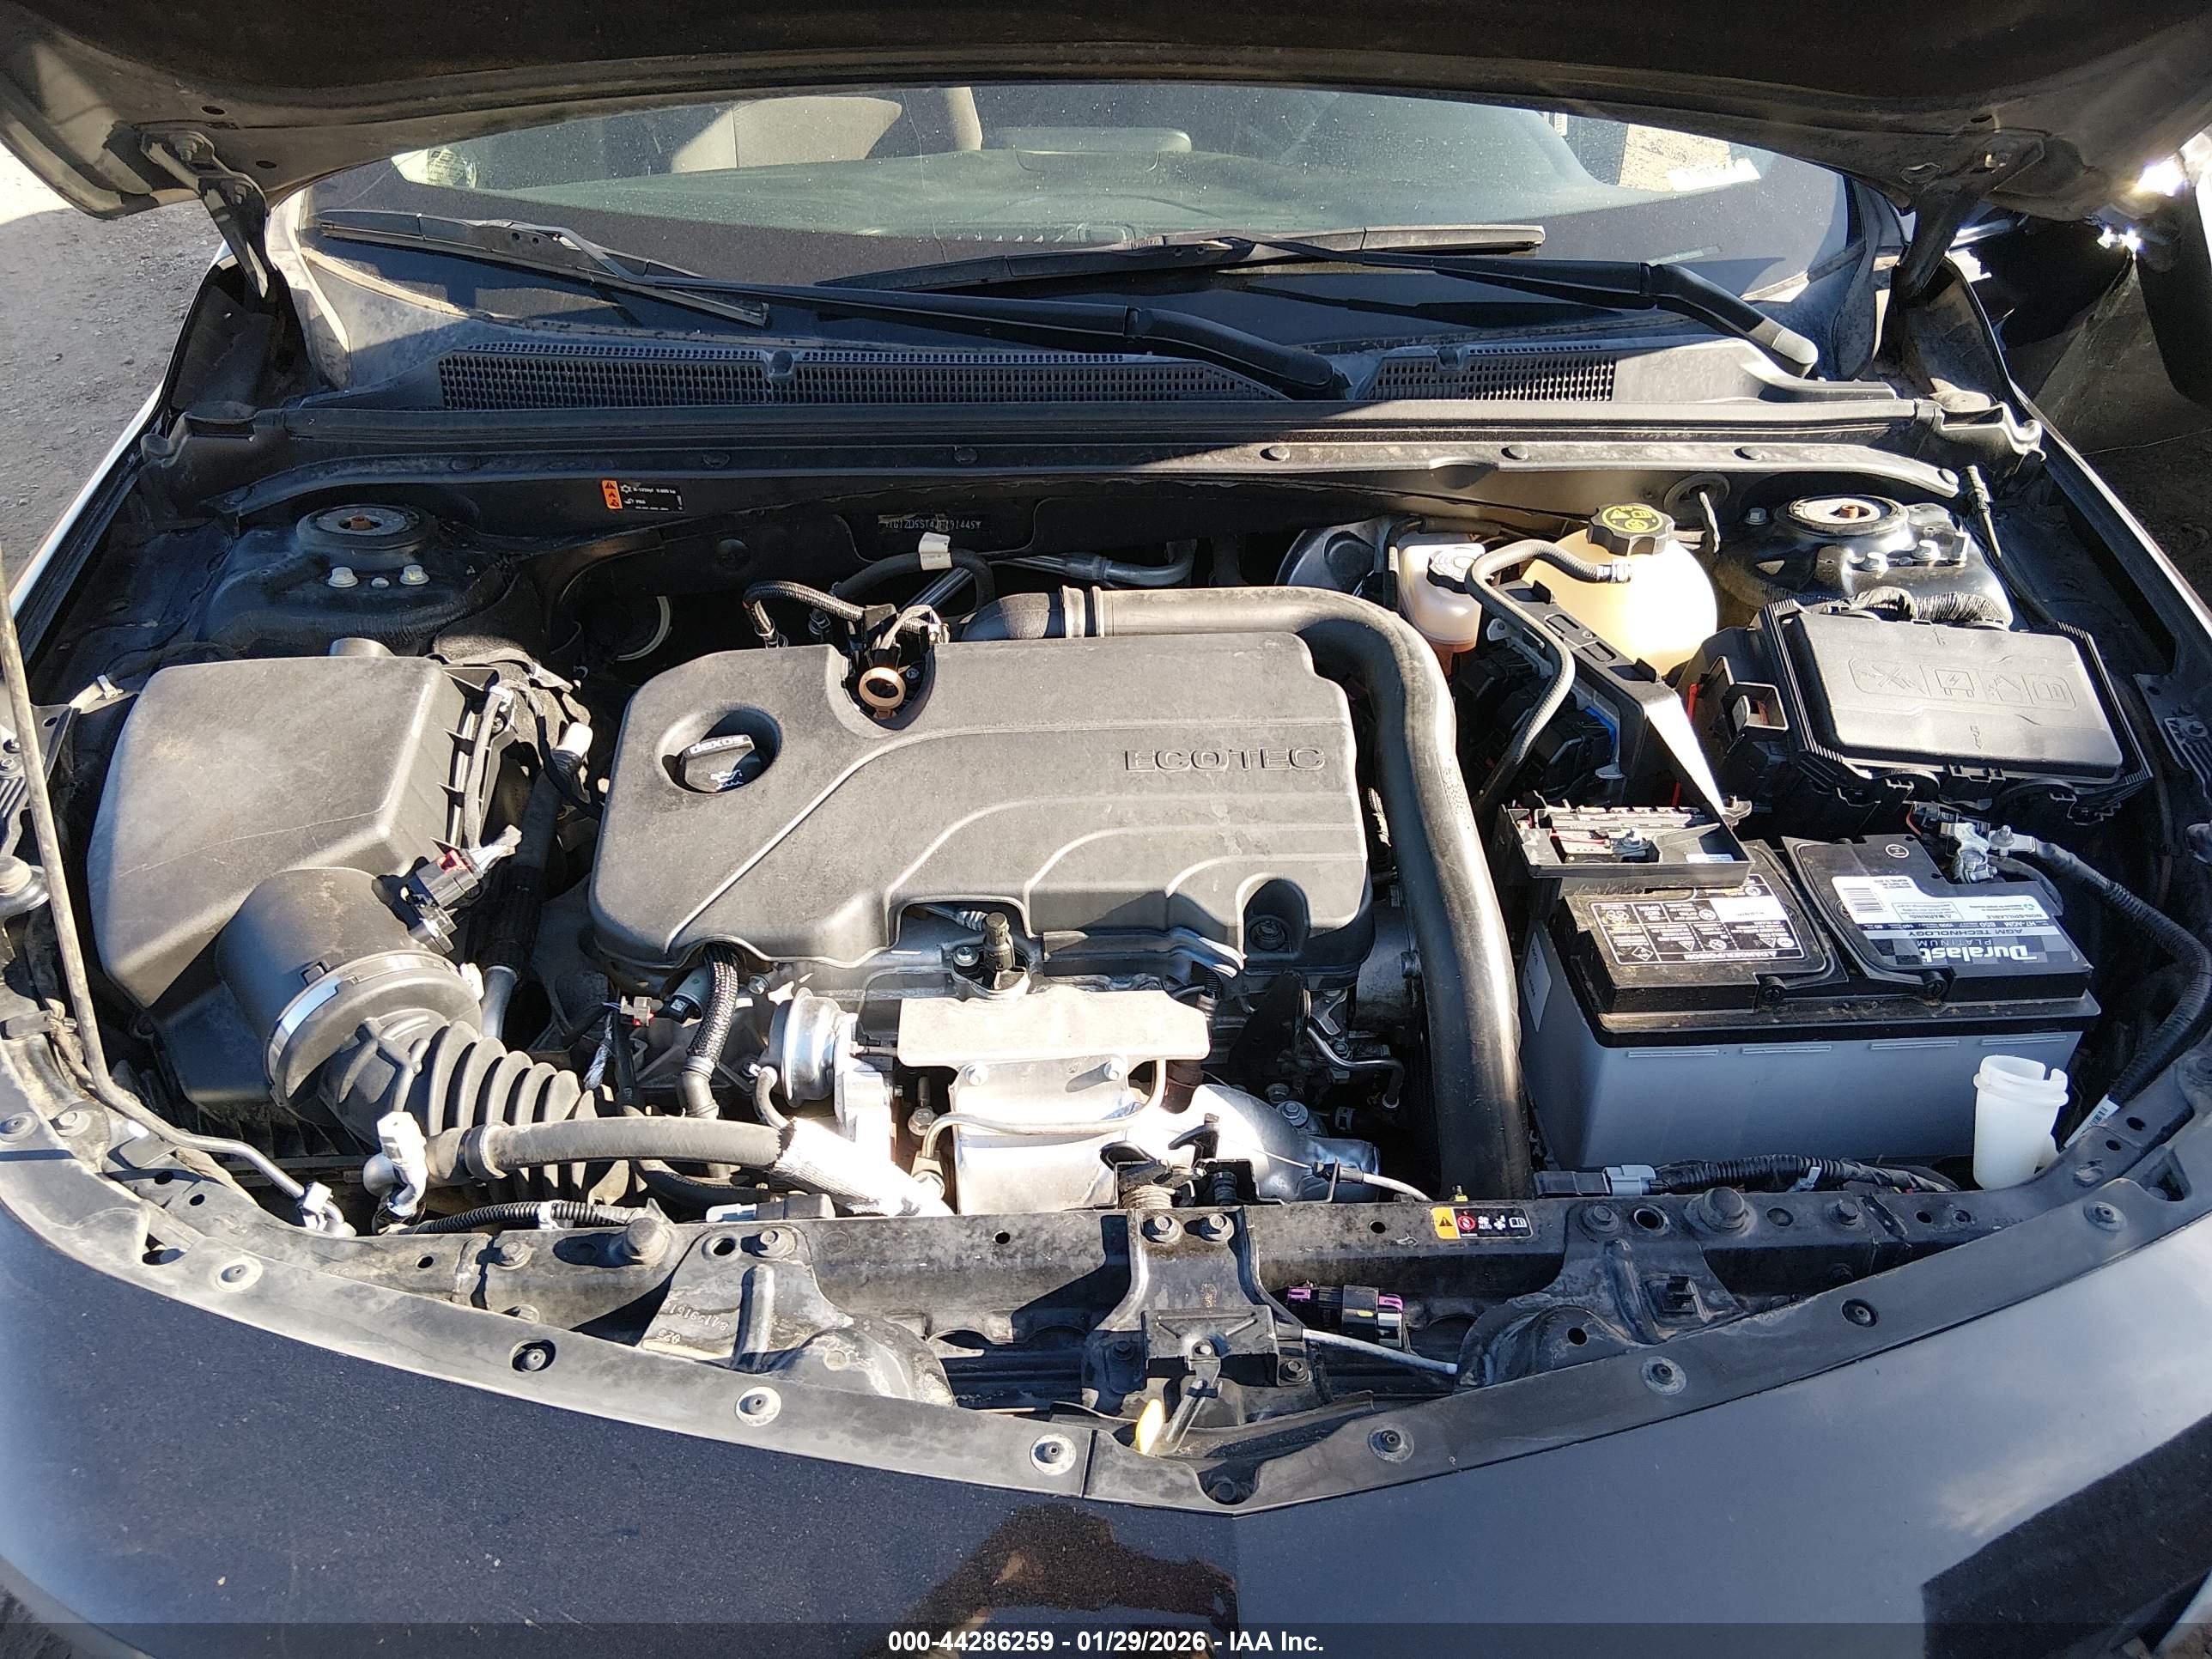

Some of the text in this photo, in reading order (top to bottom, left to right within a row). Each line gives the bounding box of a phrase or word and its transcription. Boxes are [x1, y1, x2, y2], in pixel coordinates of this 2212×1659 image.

[689, 735, 745, 754] dexos
[1123, 746, 1326, 772] ECOTEC
[1907, 927, 2023, 938] AGM TECHNOLOGY
[1916, 938, 1993, 947] PLATINUM
[1919, 945, 2038, 962] Duralast
